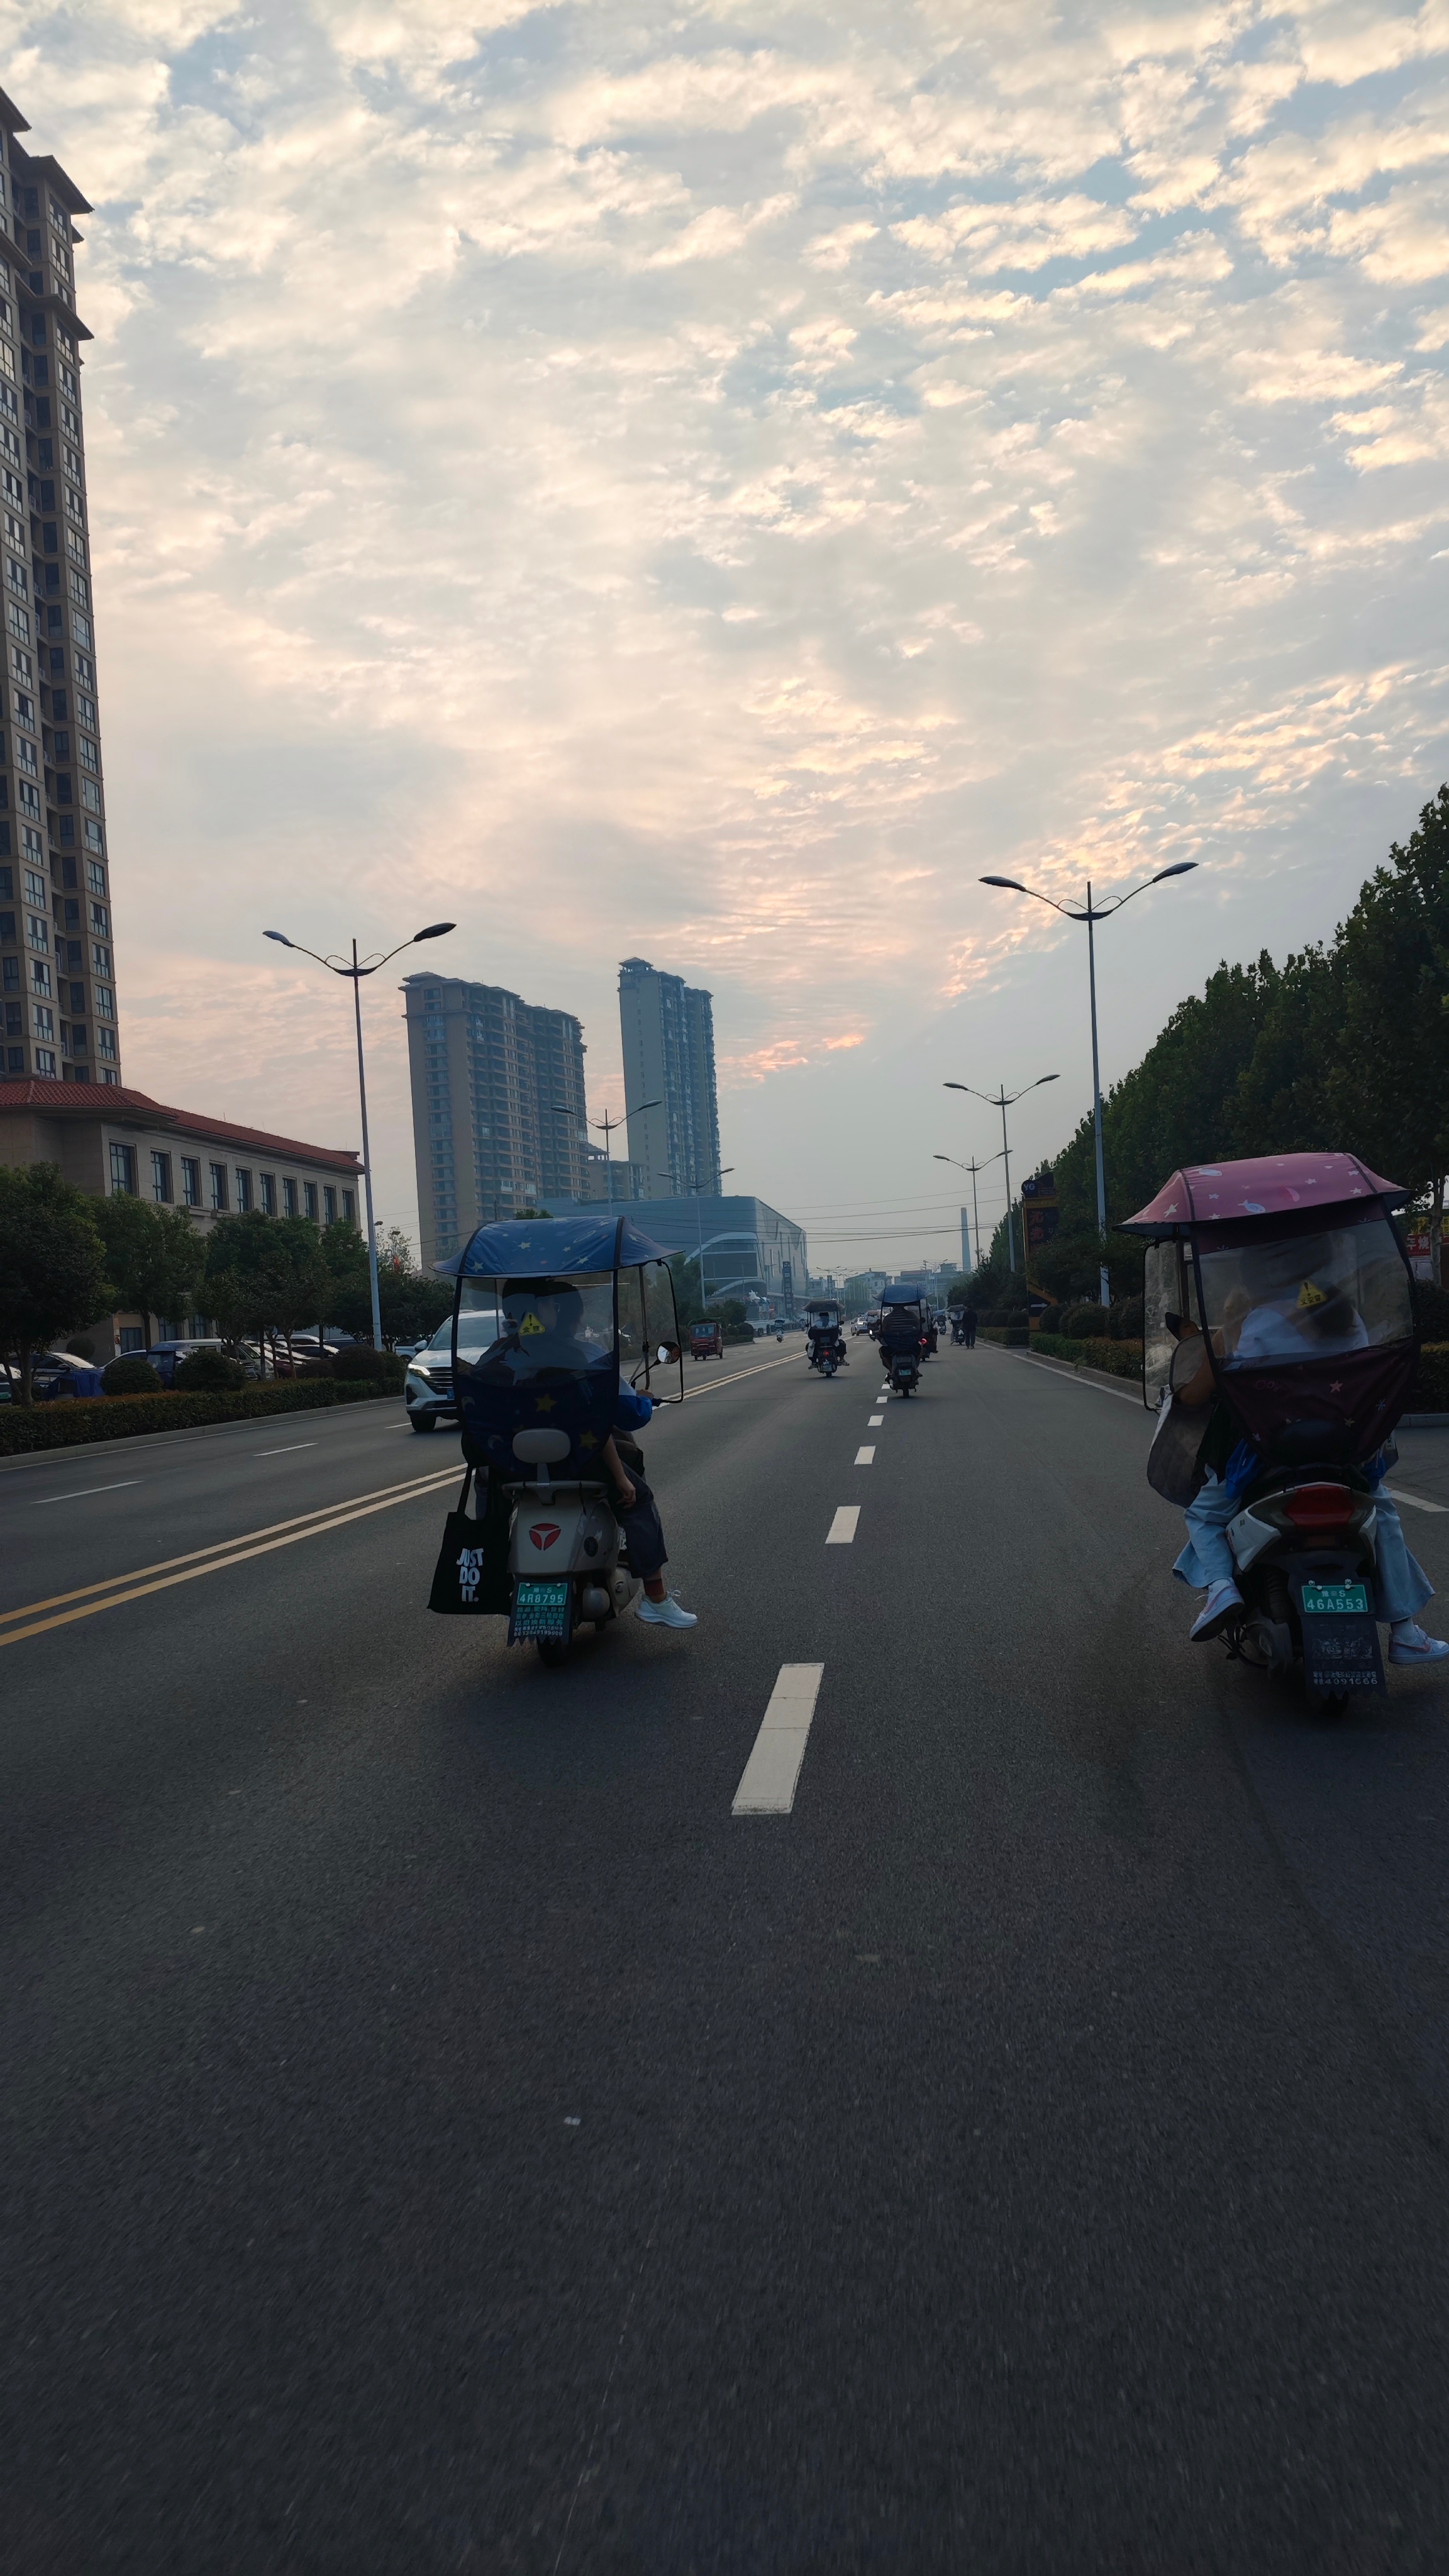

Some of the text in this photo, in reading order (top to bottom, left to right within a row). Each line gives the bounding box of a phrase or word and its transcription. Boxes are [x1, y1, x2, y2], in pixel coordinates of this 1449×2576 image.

[456, 1548, 484, 1567] JUST
[459, 1566, 480, 1585] DO
[462, 1585, 479, 1602] IT.
[1307, 1598, 1363, 1610] 46A553
